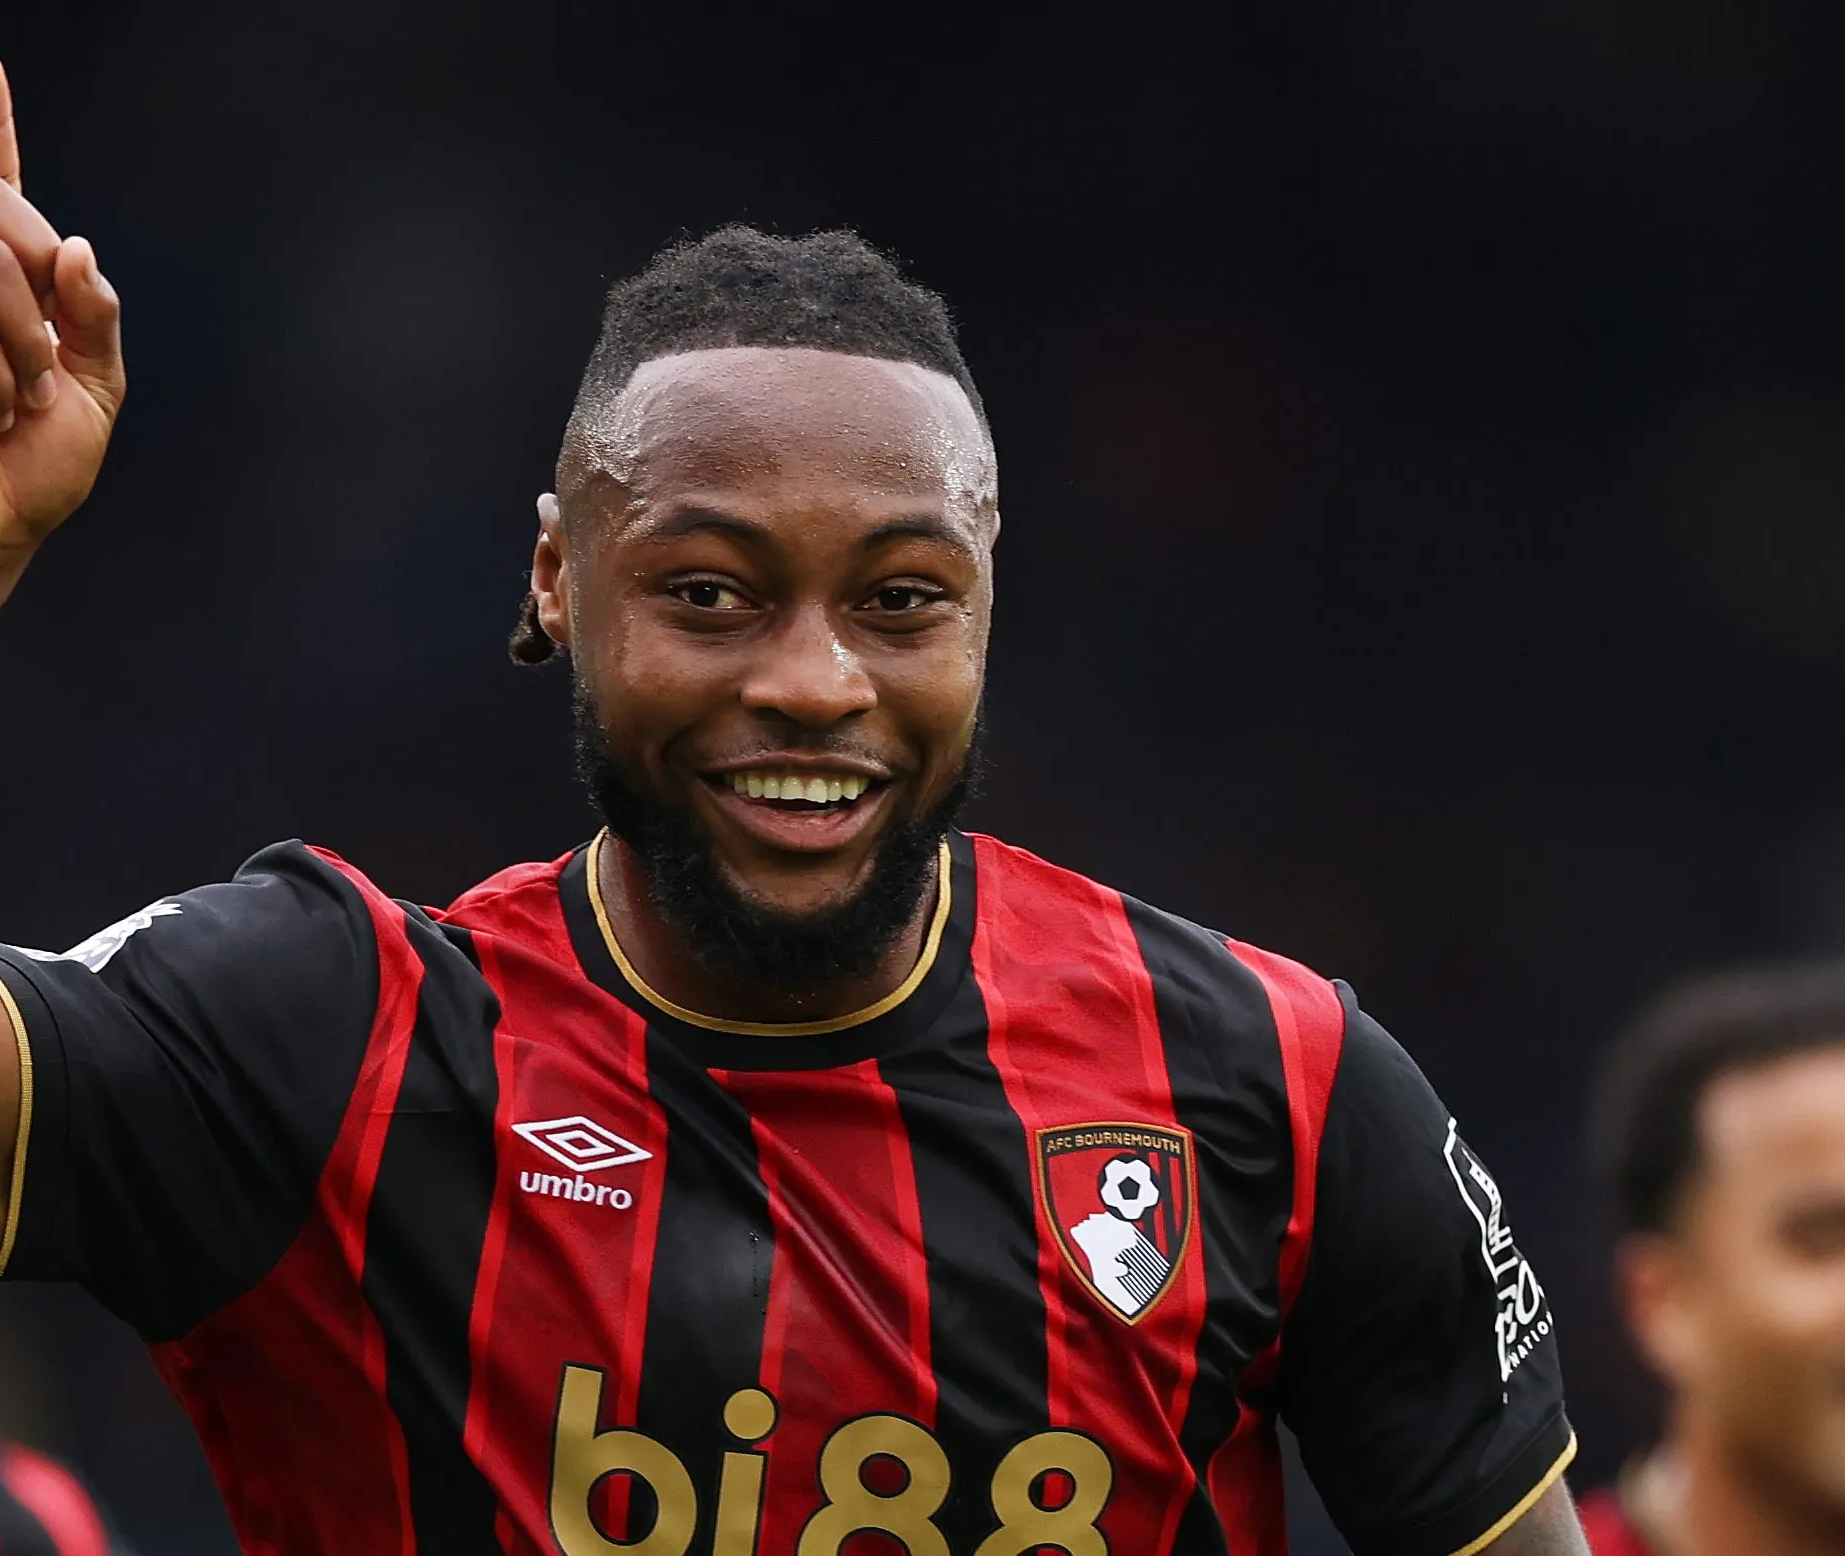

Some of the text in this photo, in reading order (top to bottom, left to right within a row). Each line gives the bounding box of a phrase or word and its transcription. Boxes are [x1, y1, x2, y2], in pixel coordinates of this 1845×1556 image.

[1046, 1131, 1182, 1155] AFC BOURNEMOUTH
[519, 1171, 633, 1210] umbro
